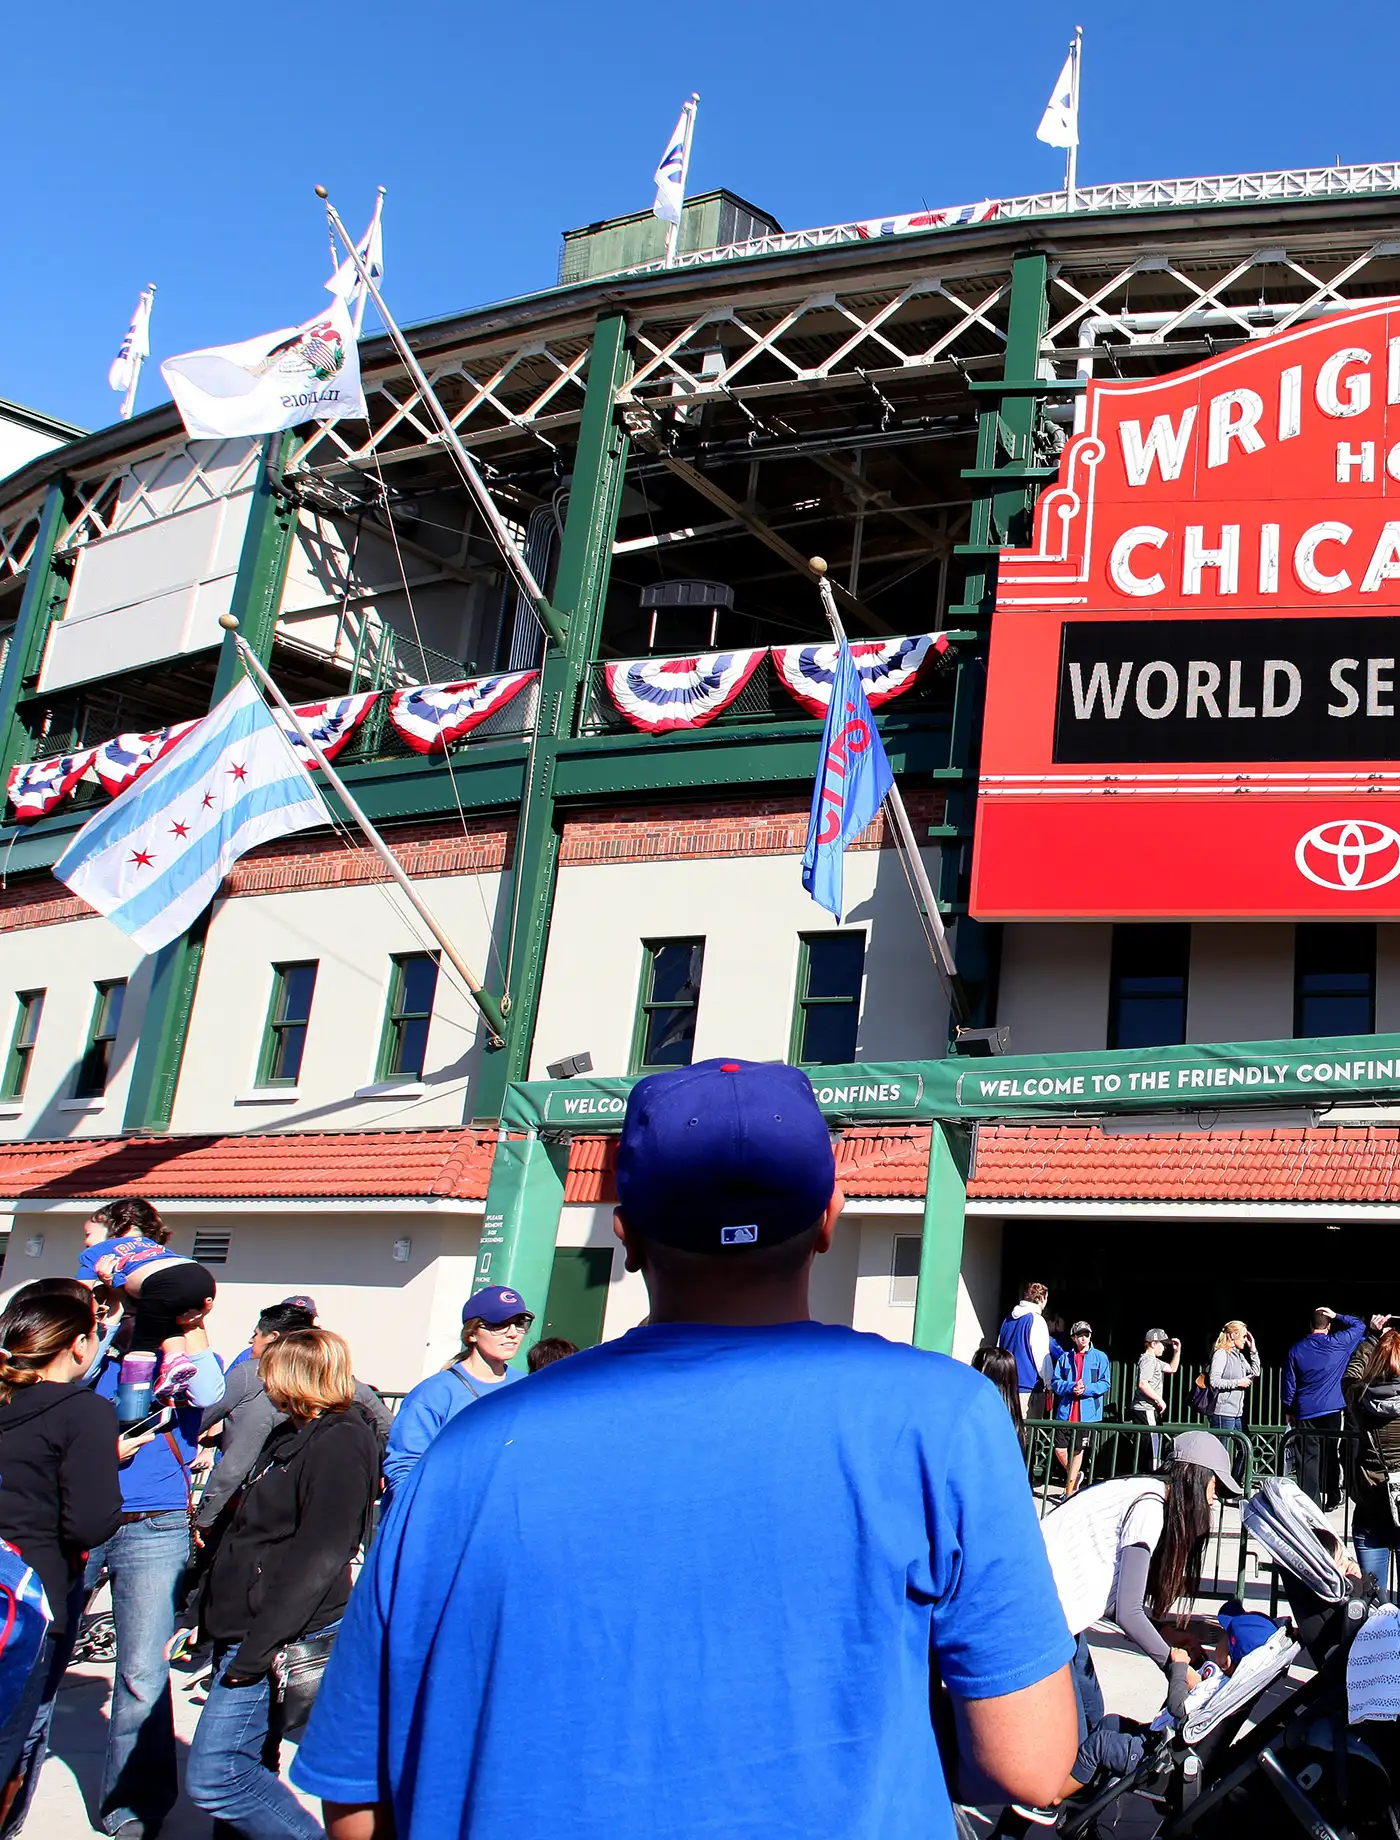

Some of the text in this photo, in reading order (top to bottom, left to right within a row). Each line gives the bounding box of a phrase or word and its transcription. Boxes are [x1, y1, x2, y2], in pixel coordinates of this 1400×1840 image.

[1068, 660, 1302, 720] WORLD
[979, 1076, 1085, 1097] WELCOME
[1094, 1073, 1122, 1093] TO
[1128, 1070, 1170, 1091] THE
[1177, 1063, 1290, 1088] FRIENDLY
[564, 1097, 627, 1115] WELCO
[499, 1291, 518, 1304] C
